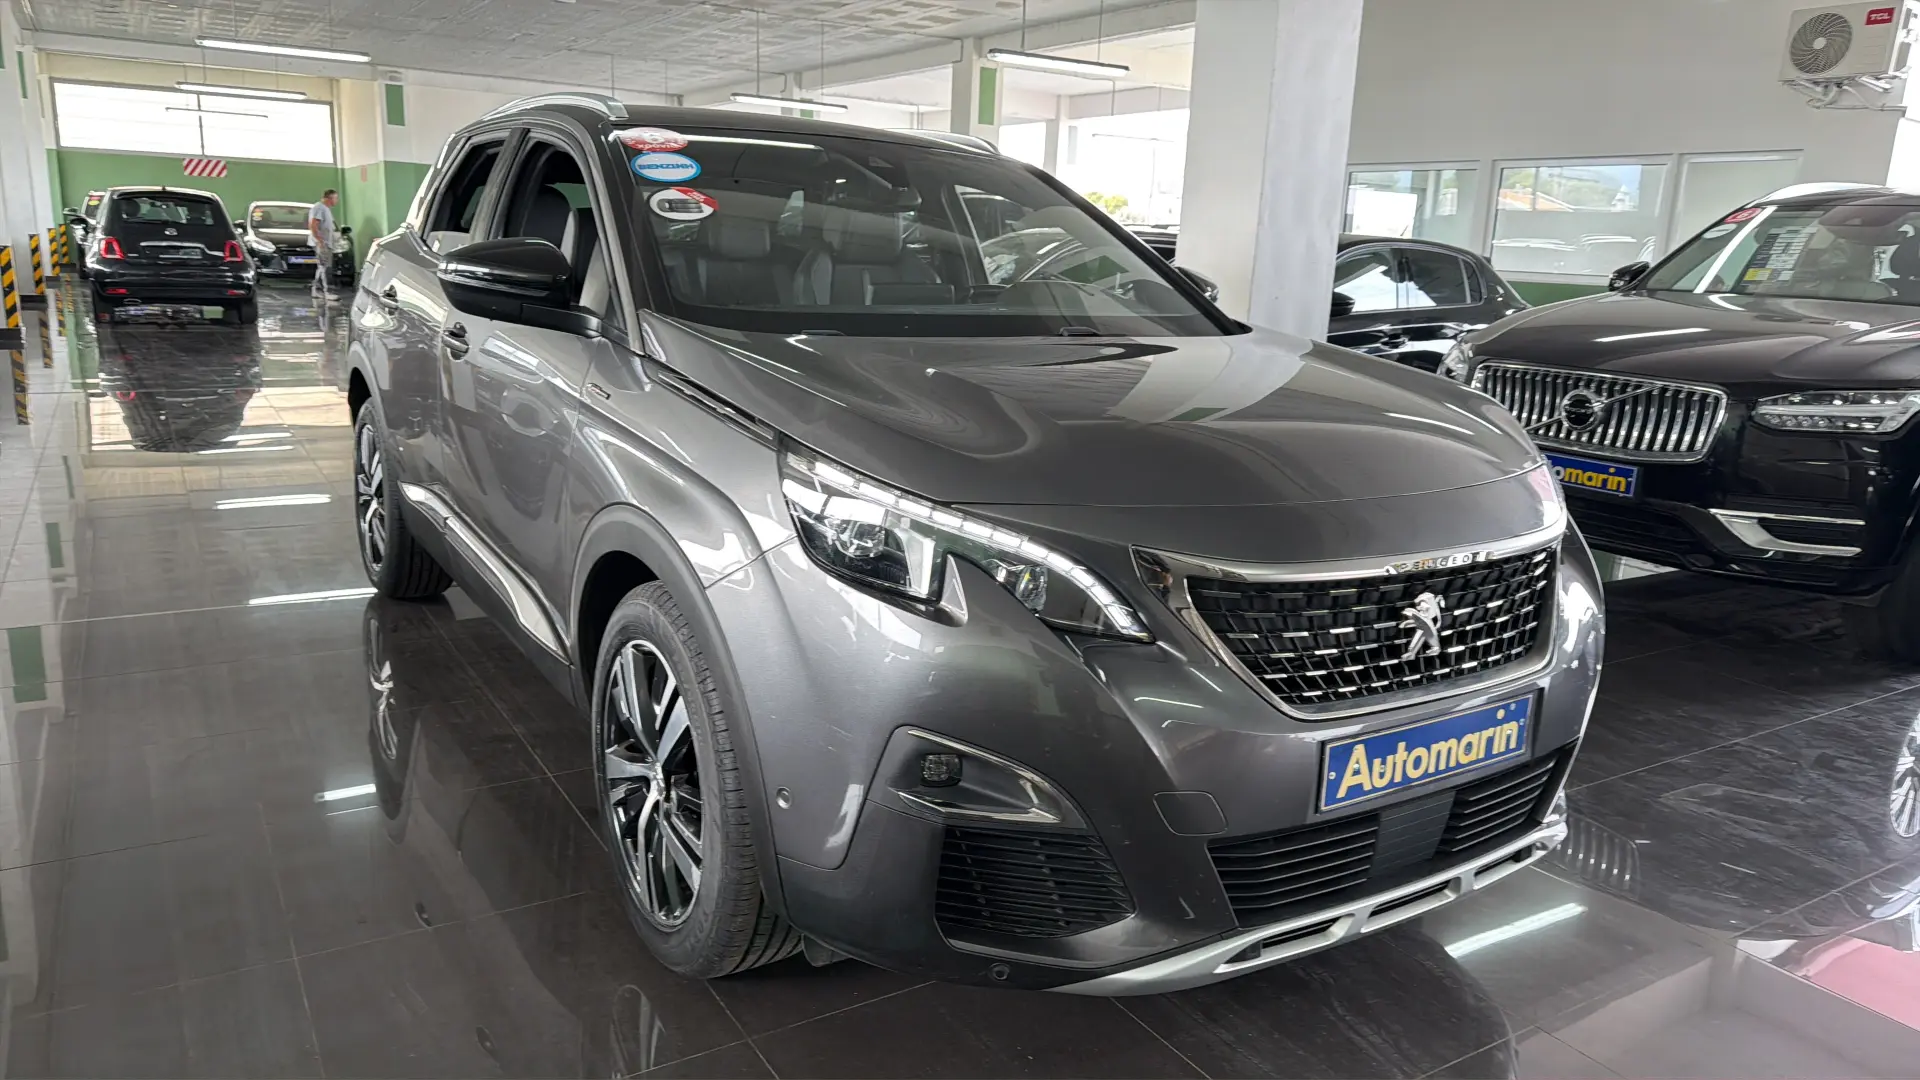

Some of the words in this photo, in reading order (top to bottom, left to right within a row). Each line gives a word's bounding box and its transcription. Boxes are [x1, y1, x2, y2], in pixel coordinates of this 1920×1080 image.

[1869, 12, 1890, 20] TCL
[1552, 466, 1626, 491] omarin
[1397, 551, 1481, 571] PEUGEOT
[1336, 709, 1518, 798] Automarin
